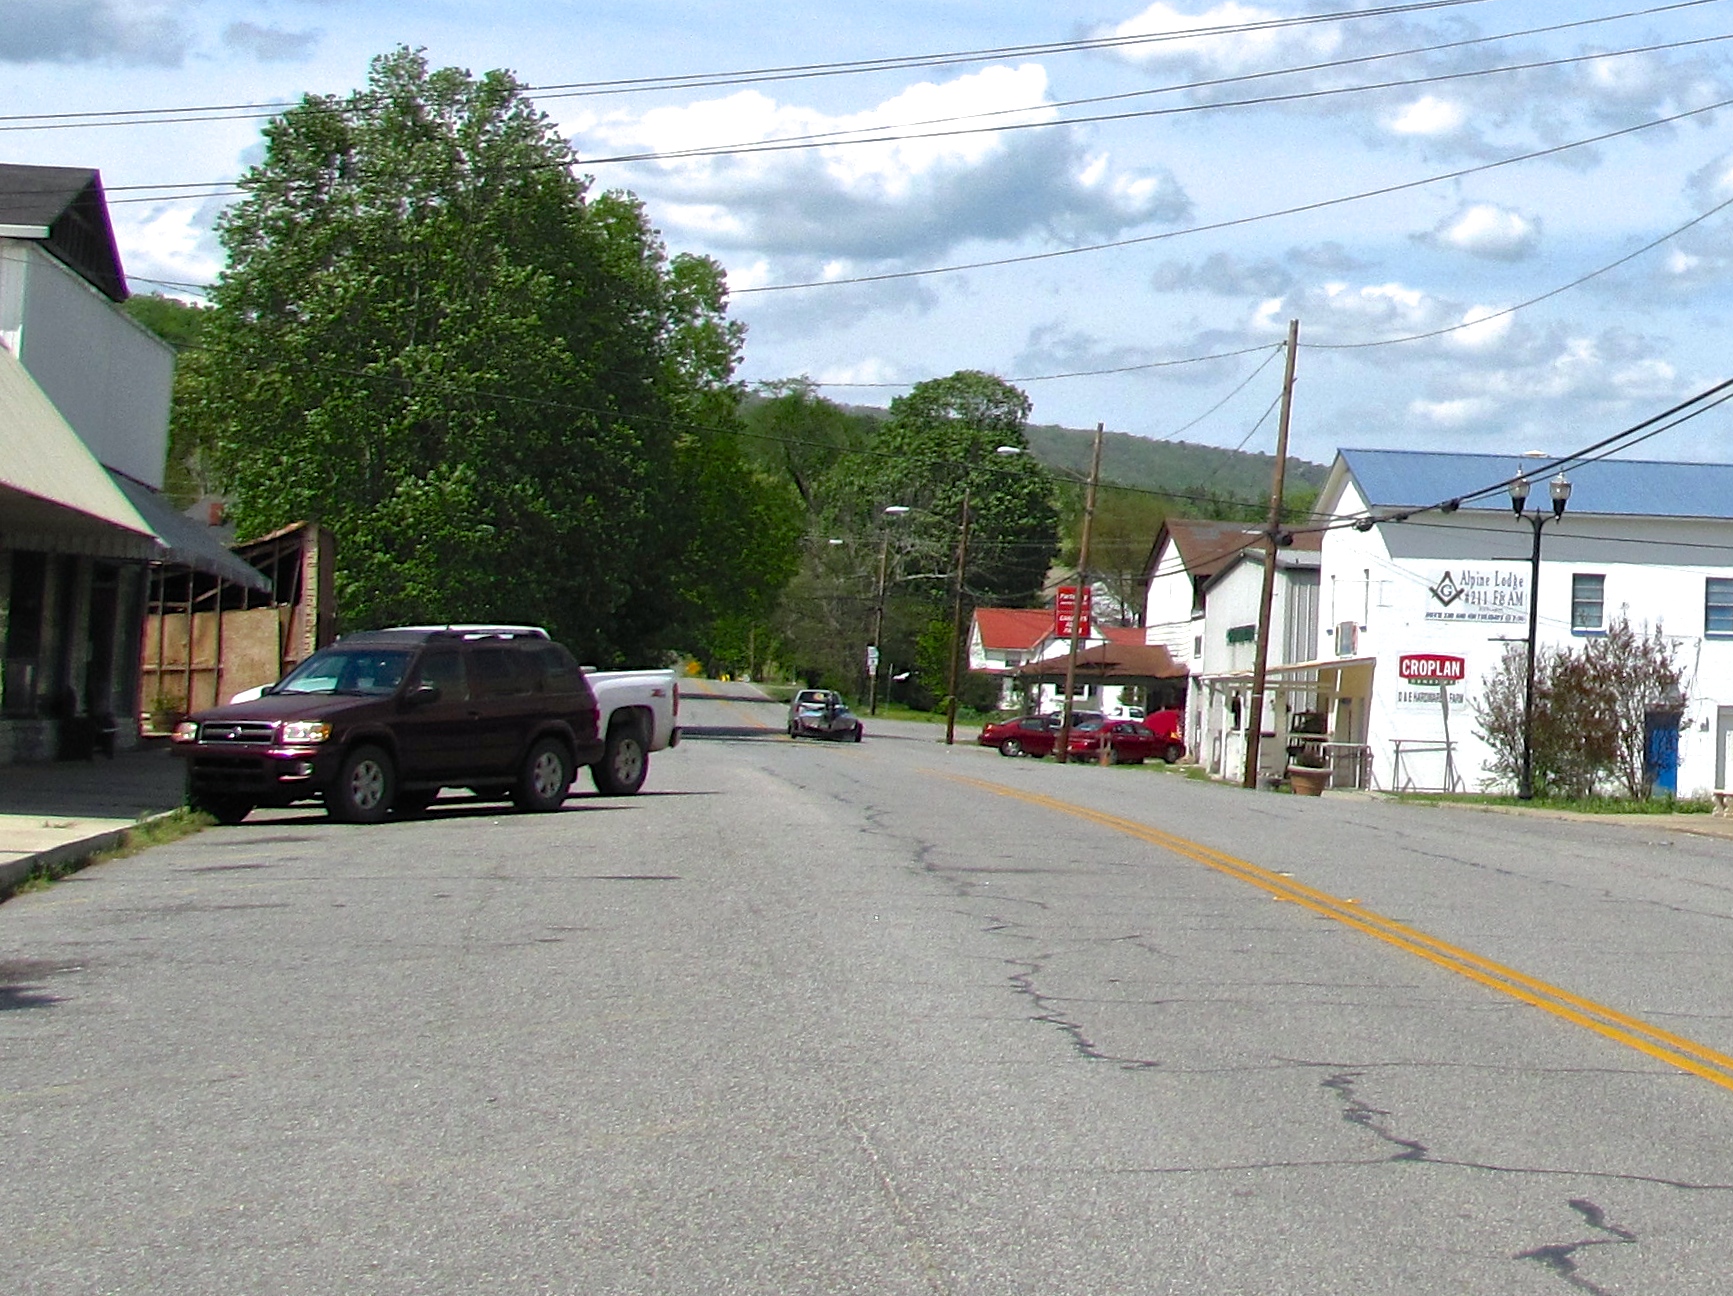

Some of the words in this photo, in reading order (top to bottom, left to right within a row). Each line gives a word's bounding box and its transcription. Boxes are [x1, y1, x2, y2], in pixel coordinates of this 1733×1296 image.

[1460, 570, 1490, 589] Alpine
[1495, 570, 1523, 590] Lodge
[1402, 659, 1461, 676] CROPLAN
